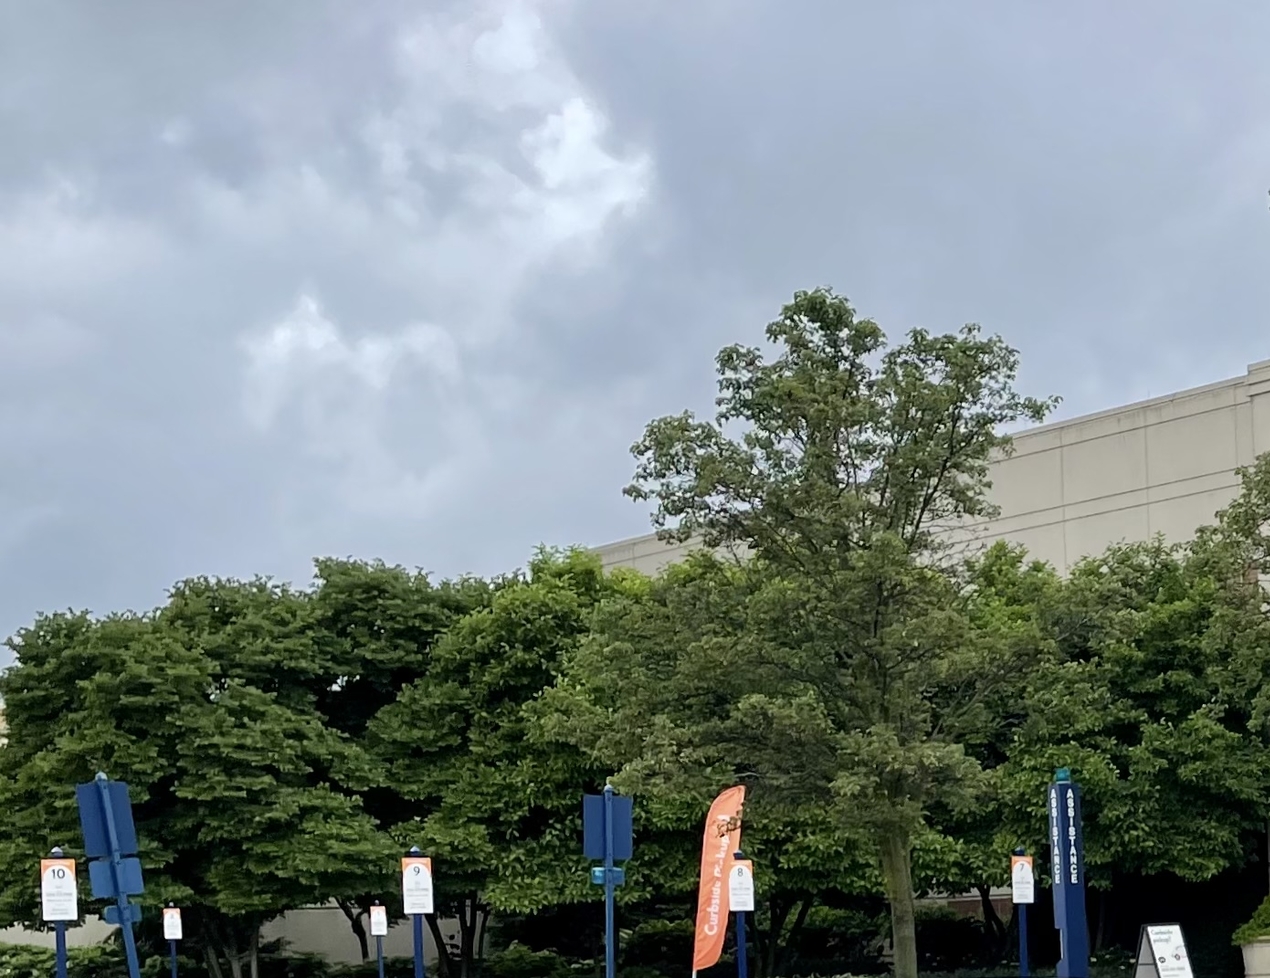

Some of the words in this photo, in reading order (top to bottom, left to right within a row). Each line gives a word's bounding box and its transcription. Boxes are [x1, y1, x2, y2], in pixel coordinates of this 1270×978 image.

[1050, 788, 1061, 884] ASSISTANCE
[1066, 788, 1079, 884] ASSISTANCE
[413, 865, 421, 876] 9
[737, 867, 743, 877] 8
[1019, 863, 1025, 872] 7
[51, 868, 66, 880] 10
[704, 880, 722, 936] Curbside
